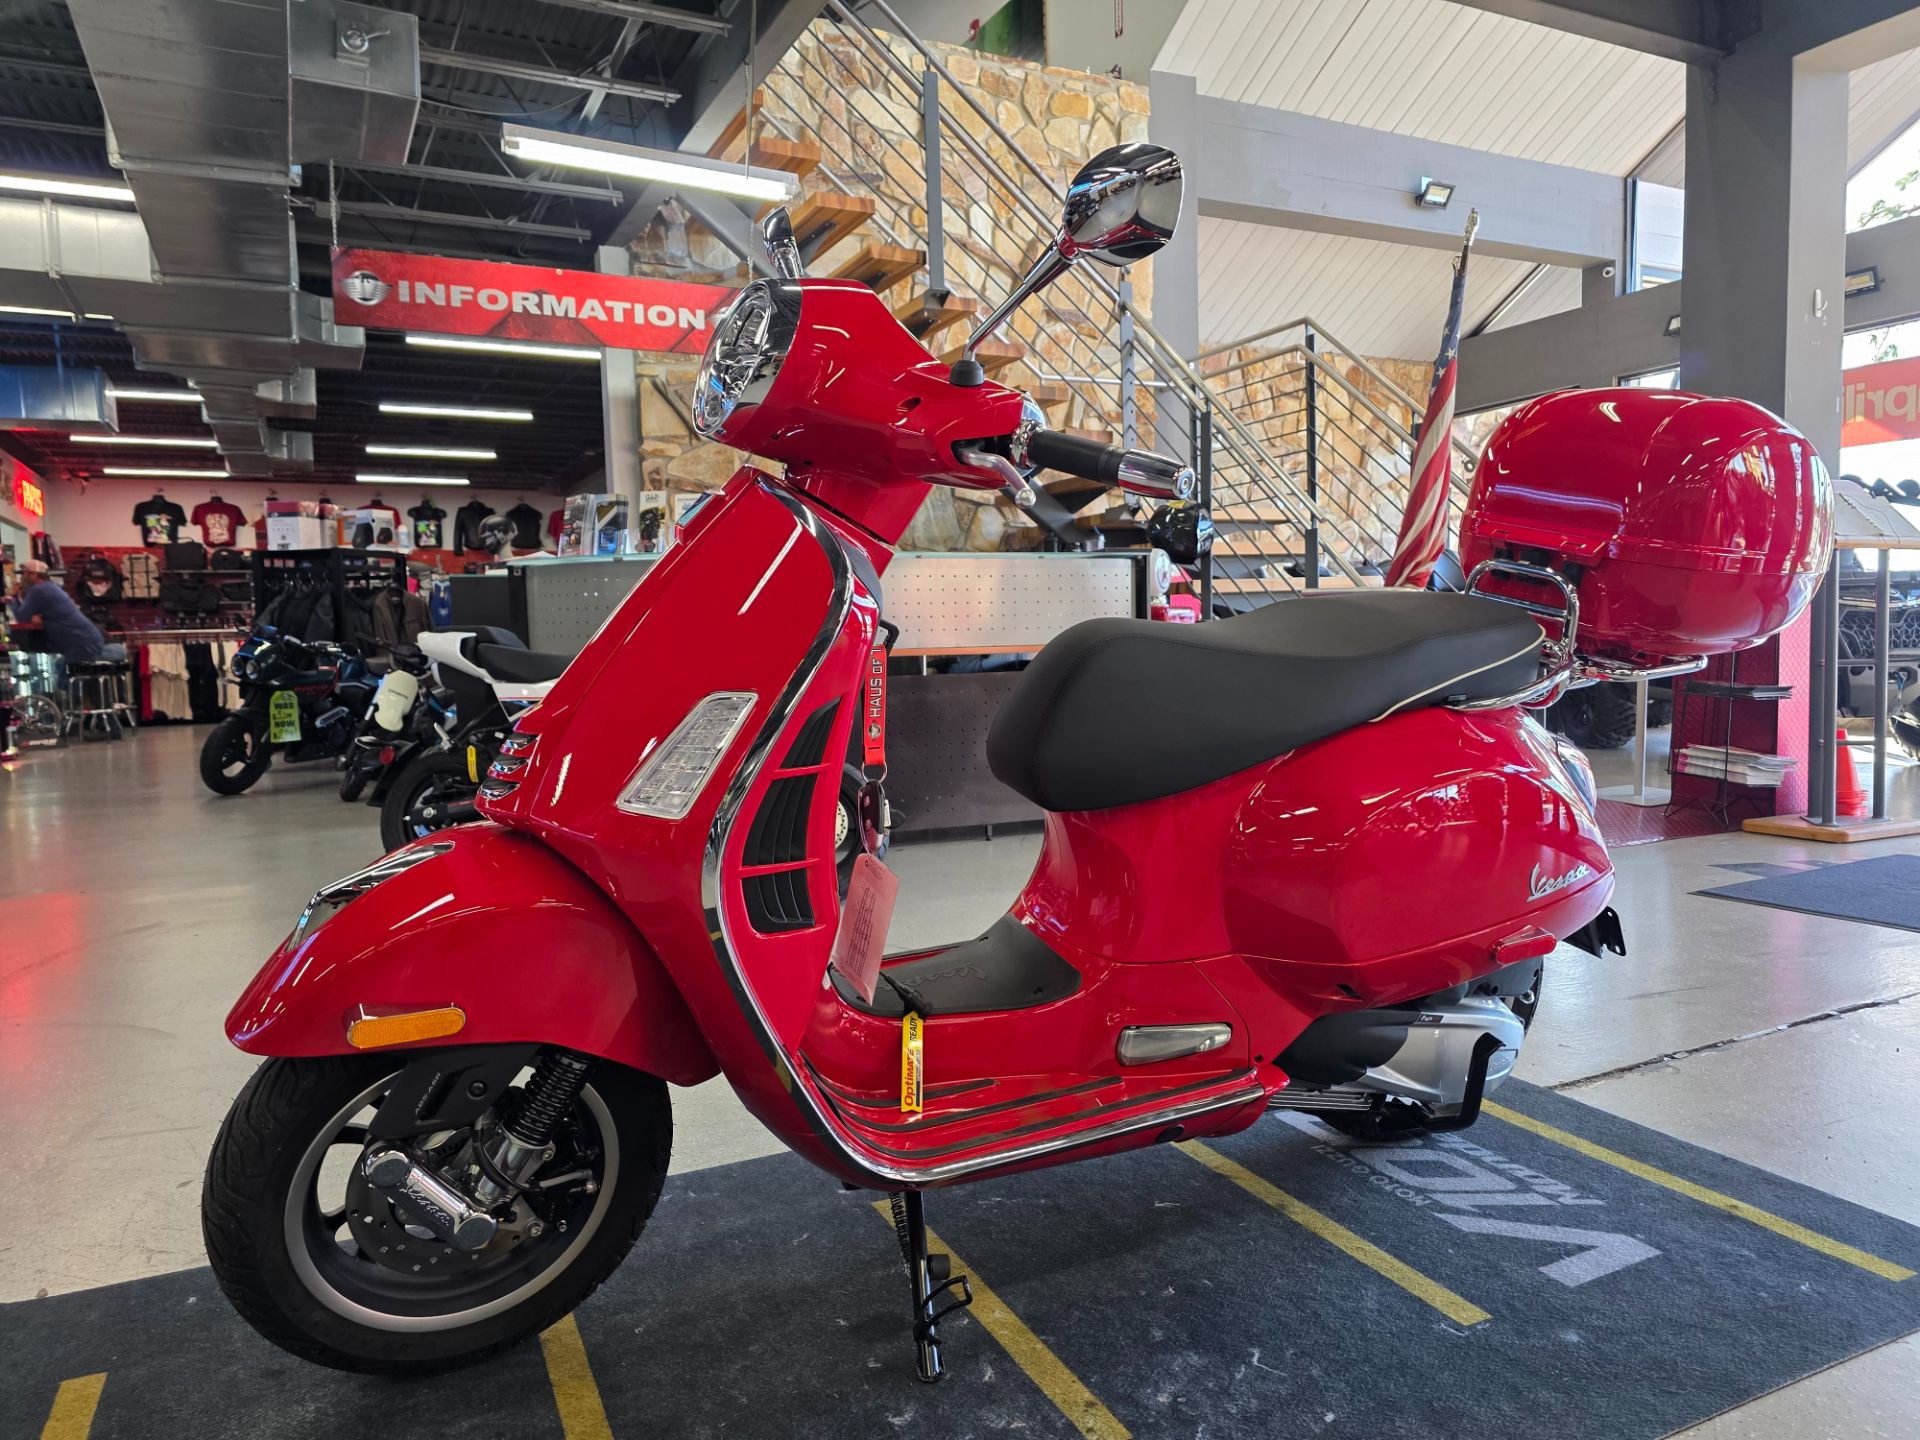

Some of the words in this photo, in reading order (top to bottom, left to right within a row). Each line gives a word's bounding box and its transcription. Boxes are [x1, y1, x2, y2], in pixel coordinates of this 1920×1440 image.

[398, 280, 705, 330] INFORMATION
[872, 658, 883, 674] OF
[869, 678, 883, 717] HAUS
[274, 720, 295, 729] NOW
[1526, 862, 1591, 903] Vespa
[1368, 1175, 1433, 1206] MOTO
